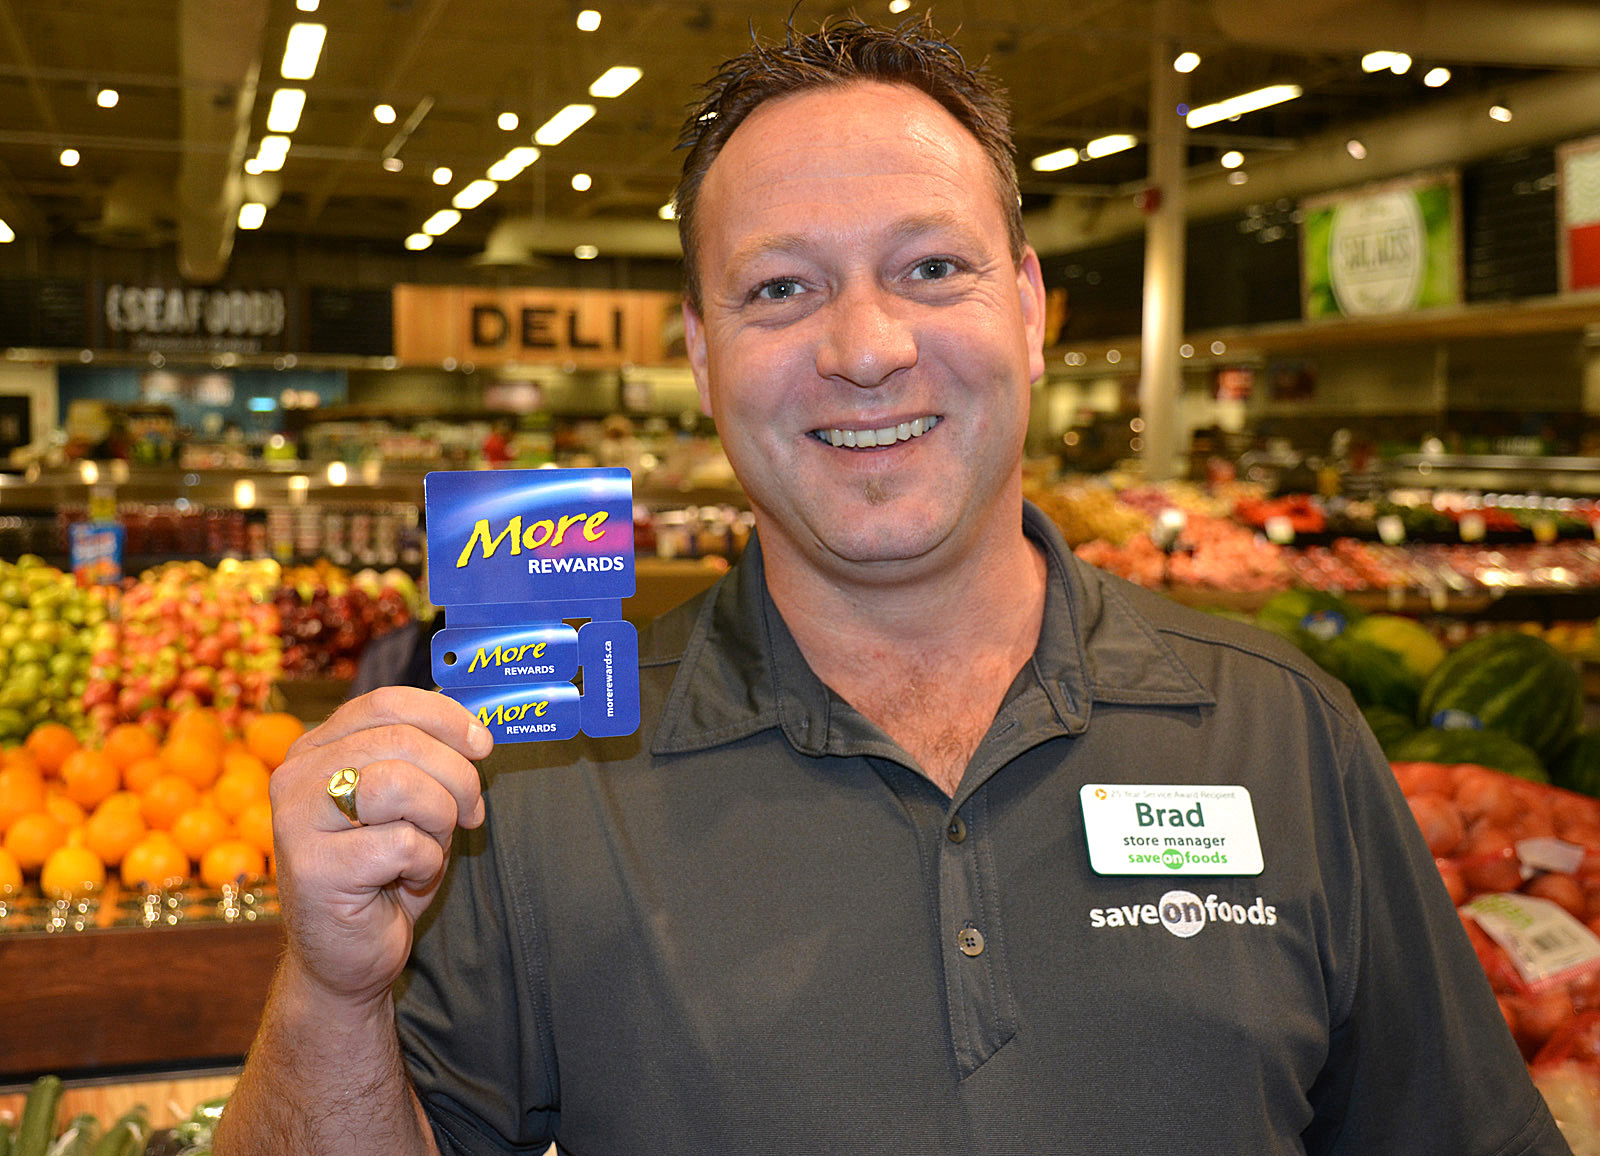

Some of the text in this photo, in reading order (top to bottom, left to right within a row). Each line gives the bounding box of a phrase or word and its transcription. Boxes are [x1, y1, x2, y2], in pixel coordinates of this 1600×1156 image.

[471, 303, 624, 350] DELI
[456, 511, 609, 568] More
[528, 556, 625, 574] REWARDS
[468, 642, 547, 673] More
[504, 665, 555, 676] REWARDS
[606, 640, 614, 718] morerewards.ca
[506, 723, 557, 735] REWARDS
[1124, 791, 1140, 799] Year
[1143, 790, 1172, 799] Service
[1174, 791, 1198, 799] Award
[1200, 791, 1235, 800] Recipient
[1135, 802, 1205, 827] Brad
[1123, 836, 1226, 849] store manager
